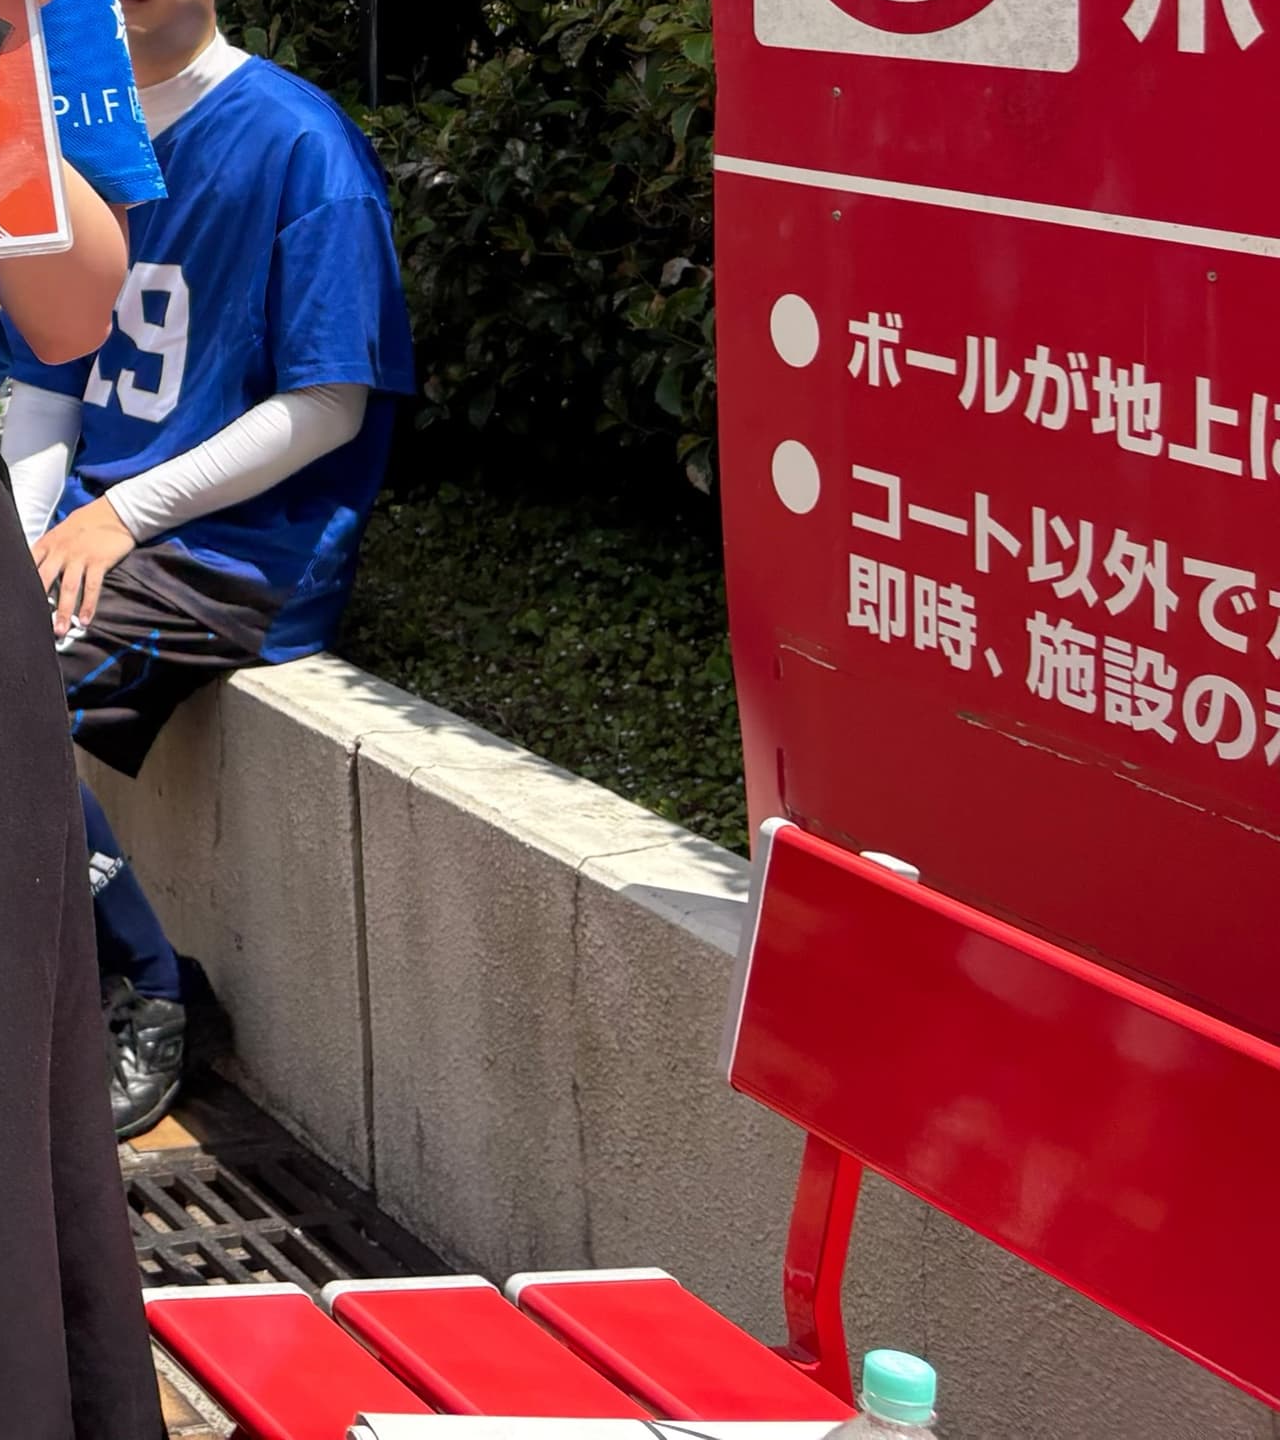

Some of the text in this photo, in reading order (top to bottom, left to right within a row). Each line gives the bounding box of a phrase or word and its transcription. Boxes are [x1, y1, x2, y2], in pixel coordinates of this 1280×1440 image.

[849, 465, 1280, 662] コート以外で
